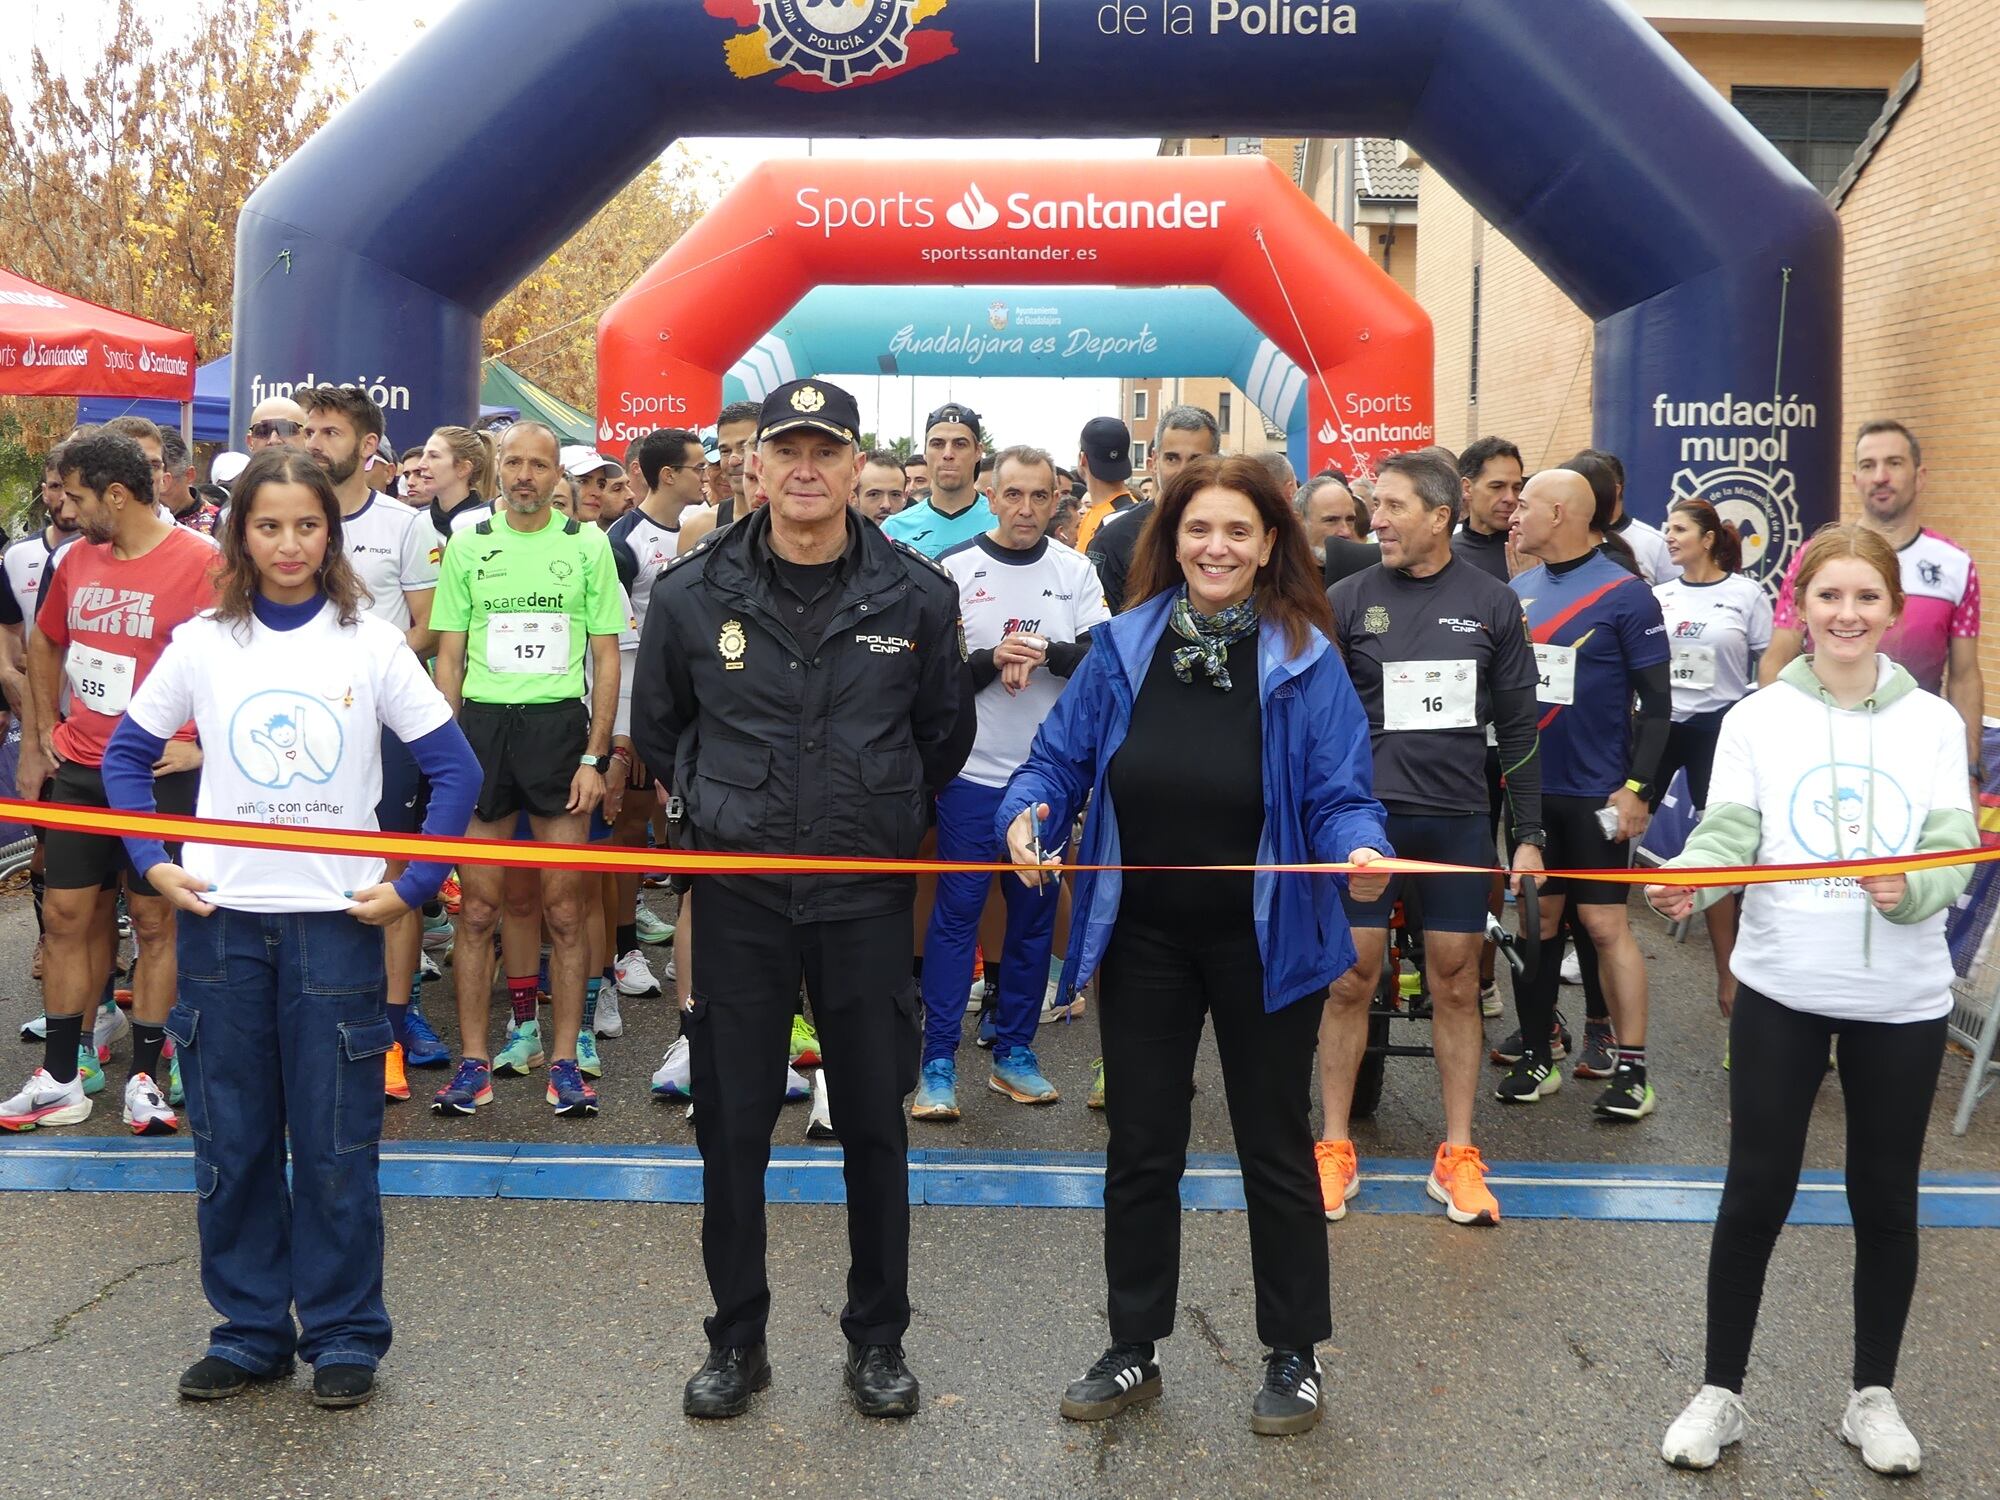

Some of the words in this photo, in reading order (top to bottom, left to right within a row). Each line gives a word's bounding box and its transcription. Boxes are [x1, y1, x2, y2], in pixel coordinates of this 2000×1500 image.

[1097, 0, 1148, 35] de
[1163, 0, 1193, 35] la
[1209, 0, 1358, 35] Policía
[806, 33, 865, 51] POLICÍA
[795, 187, 936, 238] Sports
[1006, 191, 1228, 230] Santander
[920, 244, 1098, 264] sportssantander.es
[888, 323, 1023, 365] Guadalajara
[1028, 337, 1057, 354] es
[1061, 322, 1159, 359] Deporte
[35, 343, 89, 367] Santander
[103, 344, 135, 374] Sports
[150, 351, 189, 377] Santander
[620, 391, 687, 418] Sports
[1345, 392, 1413, 418] Sports
[1653, 392, 1817, 428] fundación
[1340, 421, 1433, 443] Santander
[1681, 429, 1788, 468] mupol
[118, 588, 155, 616] THE
[493, 591, 564, 610] caredent
[125, 613, 155, 640] ON
[1451, 625, 1476, 634] CNP
[514, 645, 546, 659] 157
[869, 643, 901, 655] CNP
[1673, 668, 1695, 680] 187
[81, 678, 106, 698] 535
[1421, 696, 1444, 713] 16
[277, 801, 302, 814] con
[305, 800, 344, 815] cáncer
[269, 815, 309, 826] afanion
